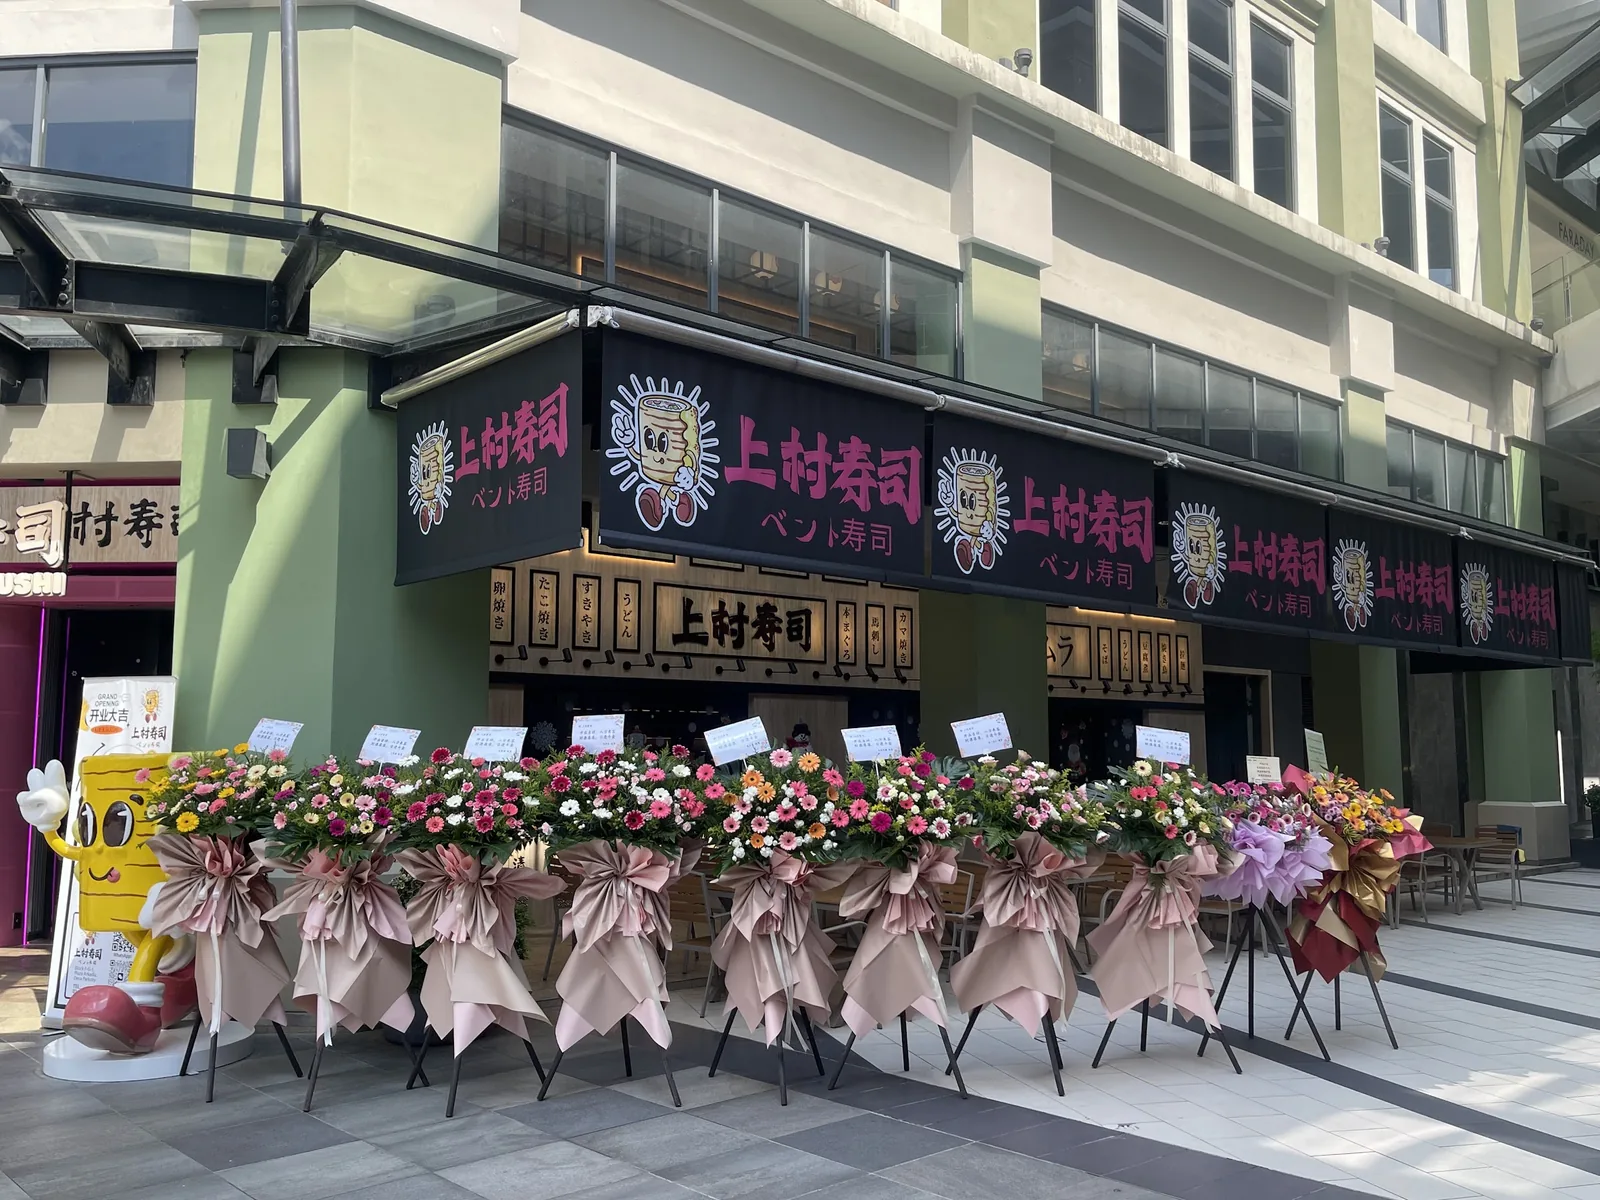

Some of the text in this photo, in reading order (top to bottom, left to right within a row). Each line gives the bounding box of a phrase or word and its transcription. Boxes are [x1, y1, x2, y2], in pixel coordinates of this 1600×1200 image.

[456, 382, 569, 482] 上村寿司
[472, 467, 547, 508] ベント寿司
[724, 415, 922, 525] 上村寿司
[0, 500, 67, 568] 司
[761, 509, 892, 556] ベント寿司
[1013, 476, 1154, 564] 上村寿司
[1039, 553, 1133, 590] ベント寿司
[1228, 523, 1326, 595] 上村寿司
[1375, 556, 1454, 615] 上村寿司
[492, 581, 507, 630] 卵焼き
[537, 576, 551, 642] たこ焼き
[581, 581, 594, 644] すきやき
[621, 593, 633, 639] うどん
[672, 596, 813, 653] 上村寿司
[1245, 589, 1312, 618] ベント寿司
[1390, 612, 1443, 636] ベント寿司
[1494, 577, 1556, 631] 上村寿司
[842, 606, 852, 660] 本まぐろ
[899, 612, 908, 664] カマ焼き
[1506, 630, 1549, 650] ベント寿司
[89, 709, 129, 723] 开业大吉
[131, 726, 168, 741] 上村寿司
